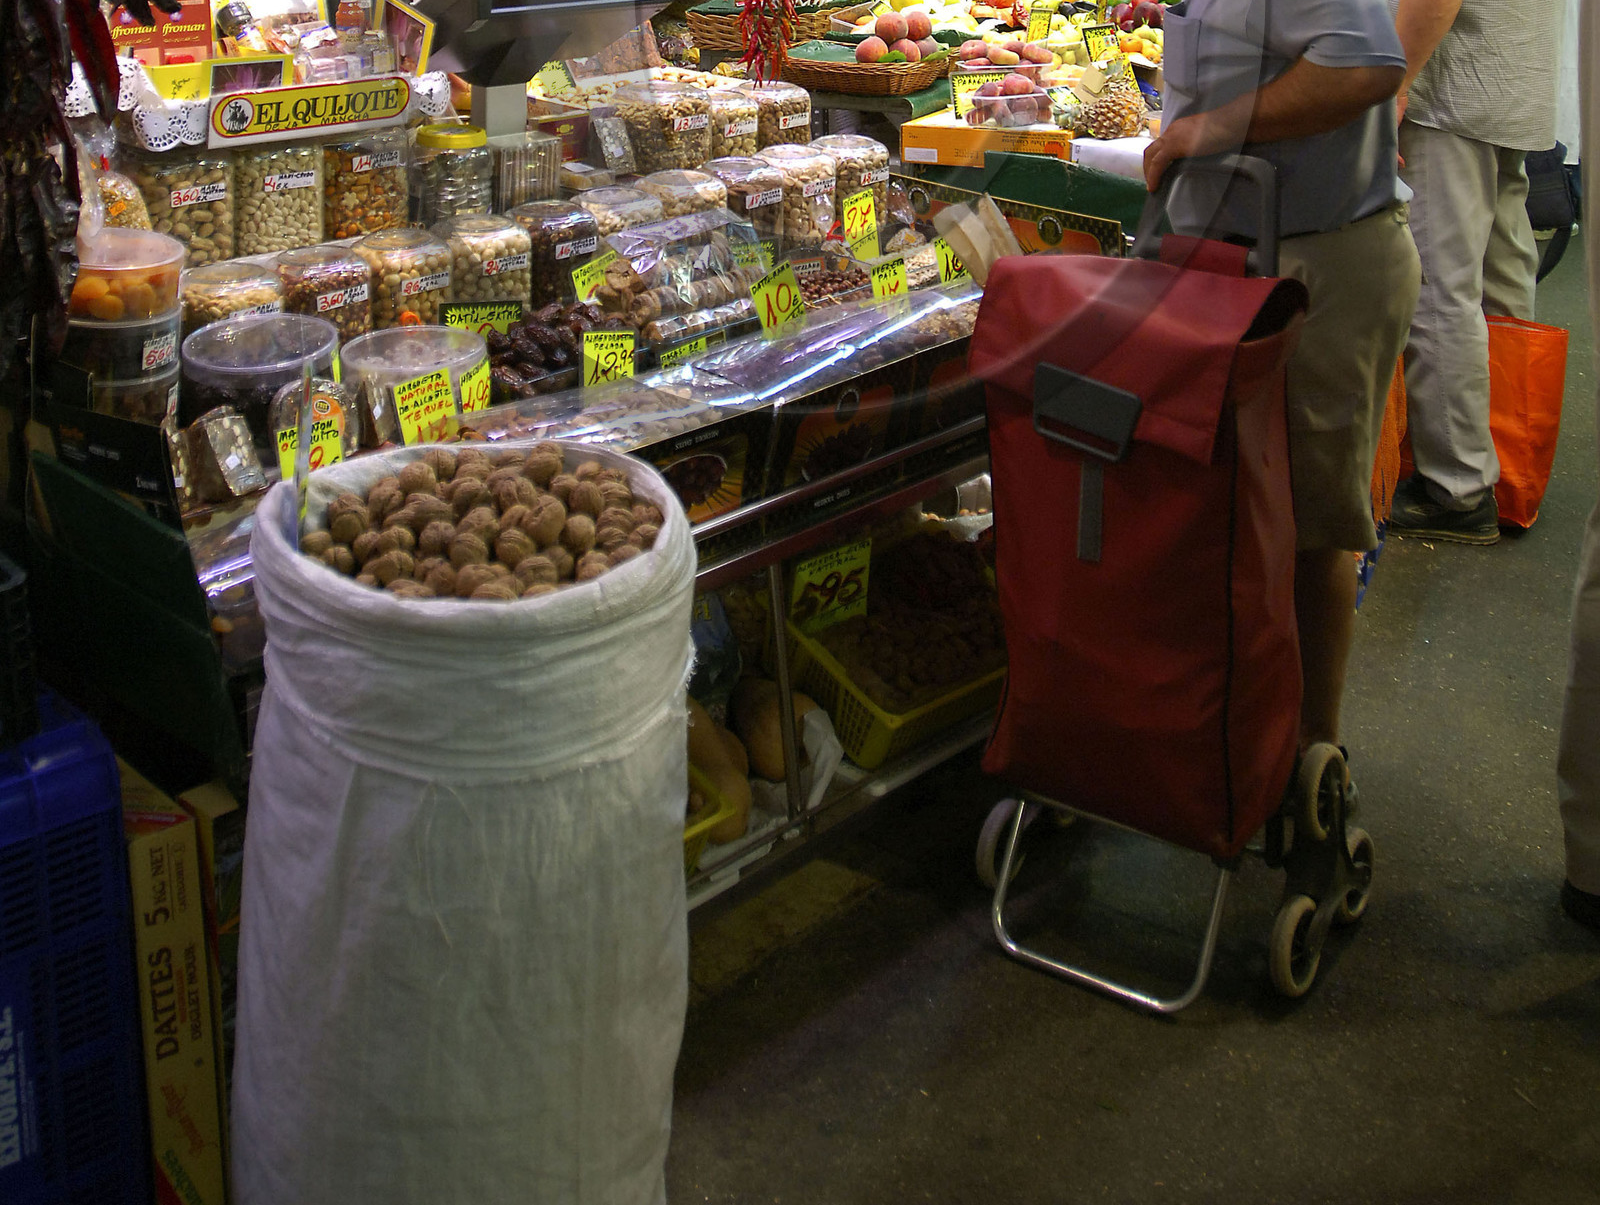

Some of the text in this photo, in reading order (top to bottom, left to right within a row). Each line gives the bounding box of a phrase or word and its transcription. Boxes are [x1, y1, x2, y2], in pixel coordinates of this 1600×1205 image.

[254, 88, 400, 125] EL QUIJOTE
[264, 123, 280, 132] DE
[320, 113, 370, 126] MANCHA
[766, 284, 792, 328] 10
[401, 380, 448, 405] NATURAL
[150, 845, 165, 877] NET
[144, 907, 170, 926] 5
[148, 947, 179, 1061] DATTES
